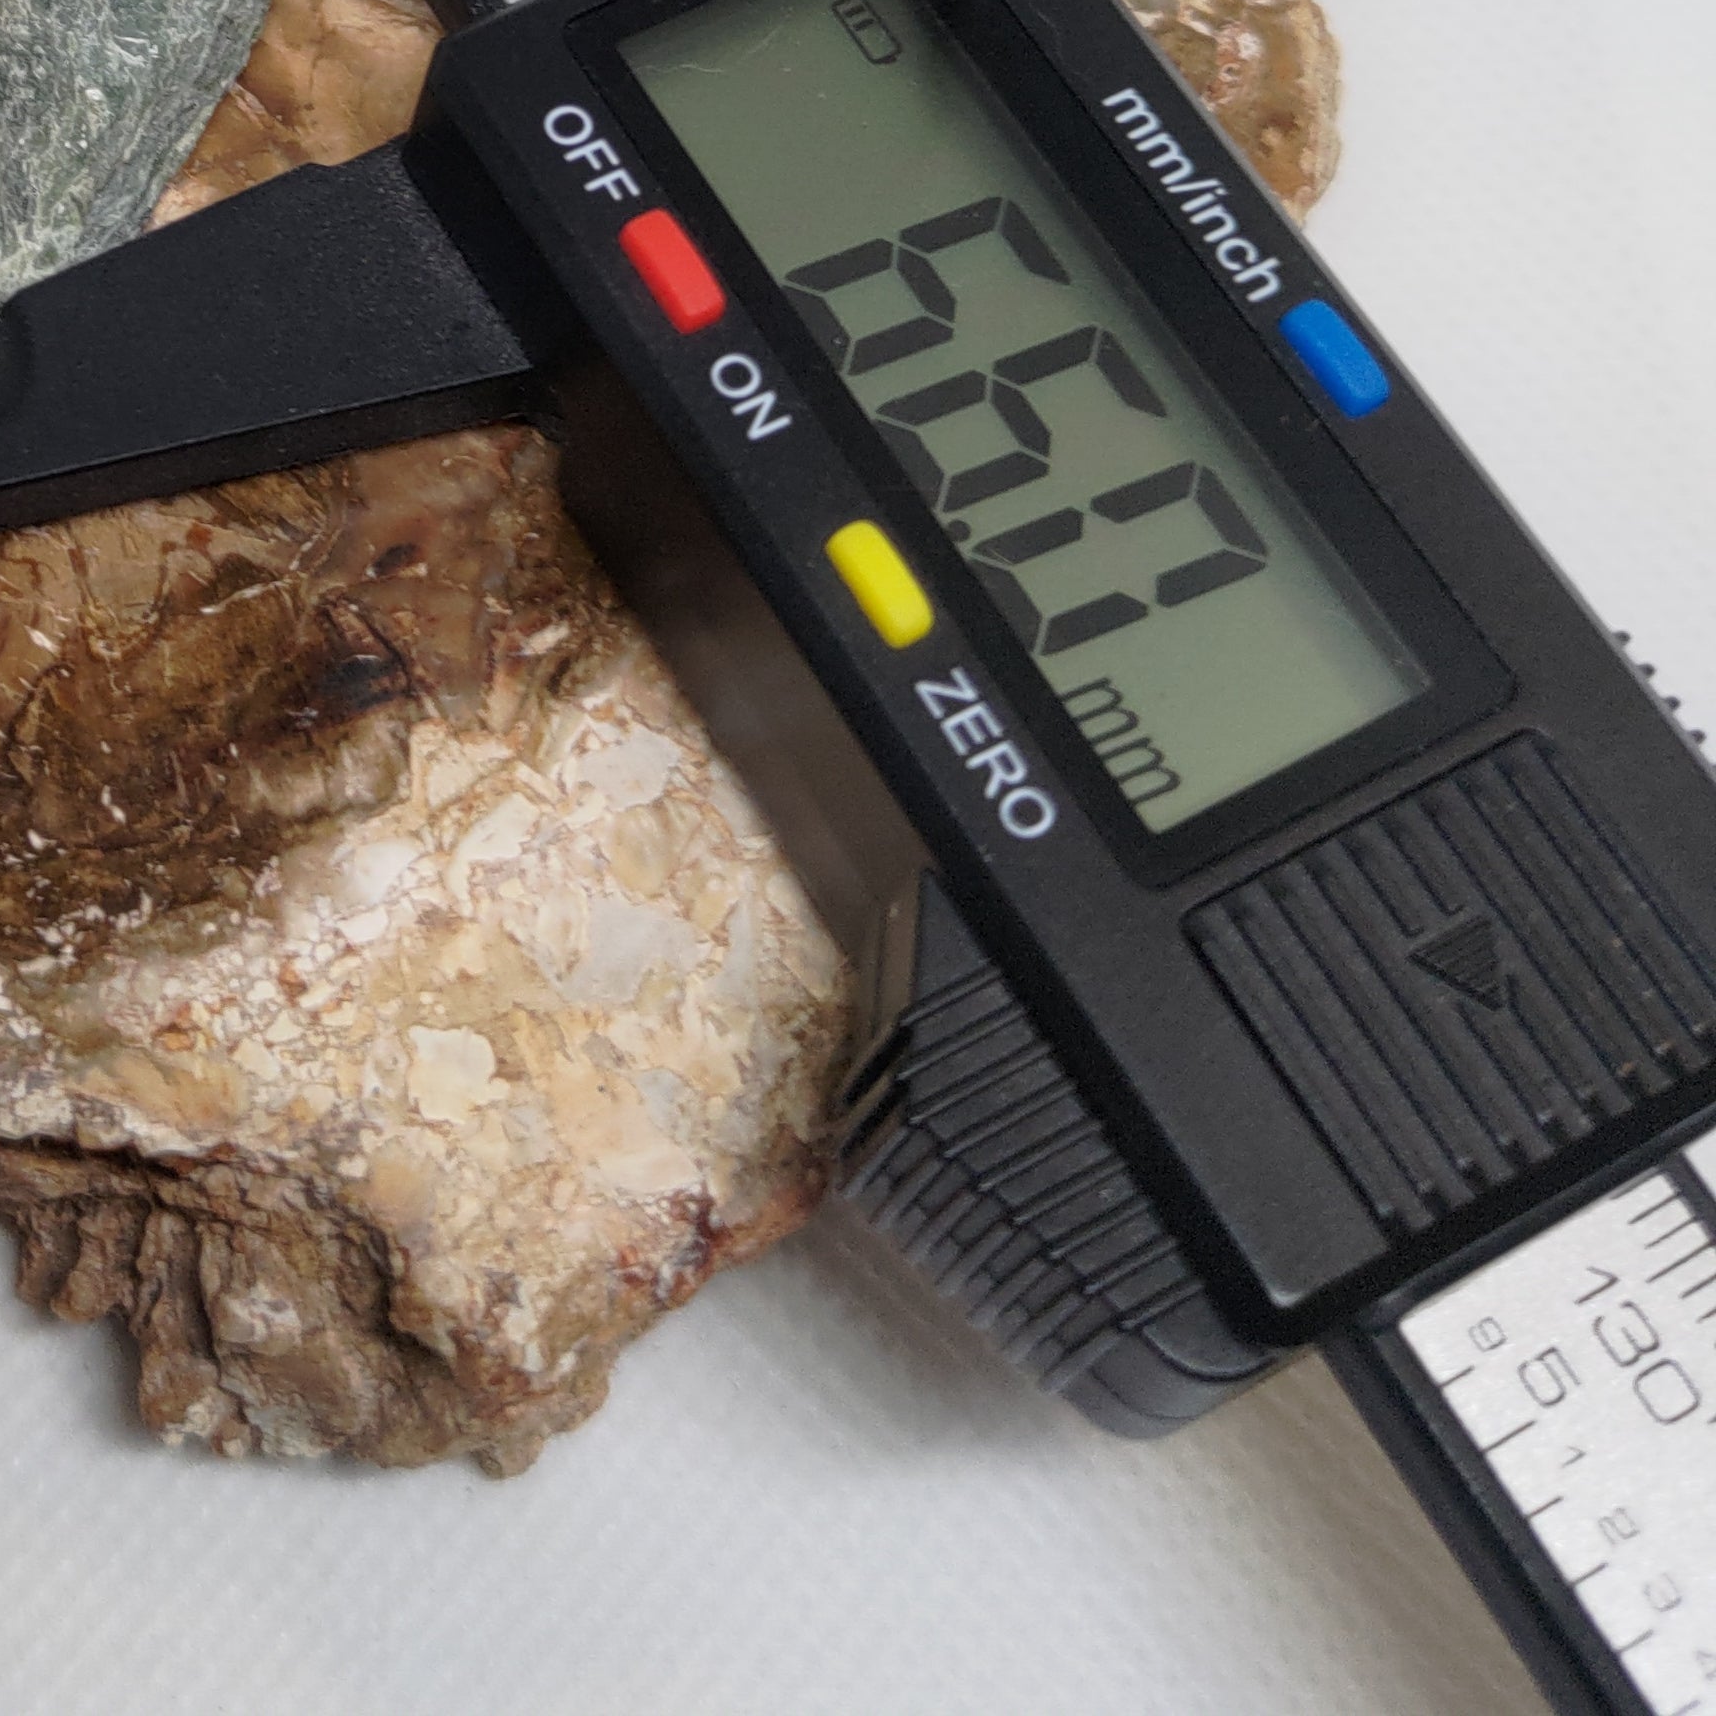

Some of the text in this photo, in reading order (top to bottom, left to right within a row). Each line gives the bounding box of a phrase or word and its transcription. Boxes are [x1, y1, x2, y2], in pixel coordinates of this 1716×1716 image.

[542, 103, 644, 206] OFF
[1101, 86, 1285, 306] mm/inch
[707, 351, 794, 444] ON
[782, 195, 1269, 808] 66.0 mm
[914, 665, 1059, 841] ZERO
[1517, 1346, 1582, 1409] 5
[1561, 1445, 1587, 1469] 1
[1574, 1266, 1702, 1426] 130
